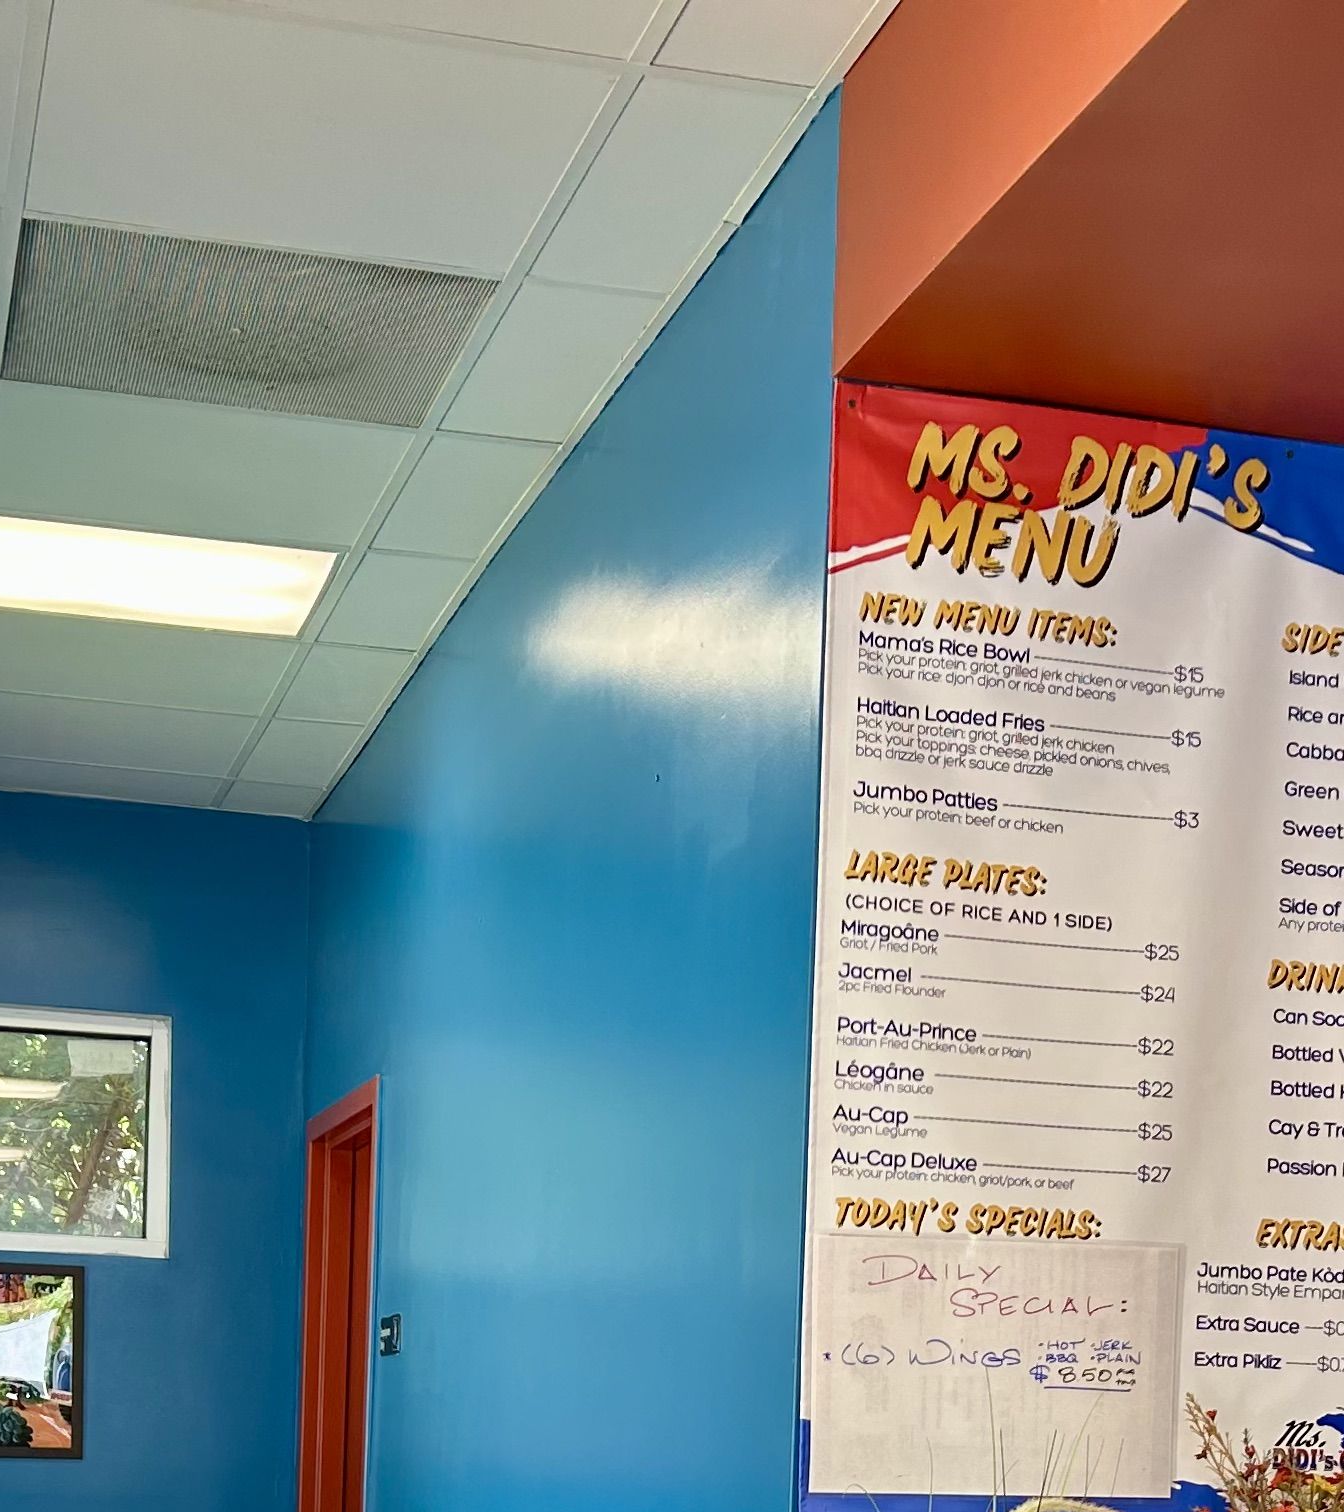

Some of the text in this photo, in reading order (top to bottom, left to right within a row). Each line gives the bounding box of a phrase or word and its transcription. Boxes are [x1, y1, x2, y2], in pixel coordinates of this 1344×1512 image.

[907, 421, 1272, 532] MS. DIDI'S
[905, 496, 1120, 588] MENU
[859, 591, 1118, 648] NEW MENU ITEMS:
[859, 630, 1204, 684] Mama's Rice Bowl $15
[1289, 670, 1339, 688] Island
[857, 697, 1201, 748] Haitian Loaded Fries $15
[1288, 706, 1323, 724] Rice
[1285, 781, 1339, 800] Green
[854, 781, 1199, 829] Jumbo Patties $3
[854, 802, 1064, 834] Pick your protein: beef or chicken
[1283, 820, 1344, 840] Sweet
[844, 849, 1048, 896] LARGE PLATES:
[846, 893, 1112, 932] (CHOICE OF RICE AND 1 SIDE)
[1279, 898, 1317, 915] Side
[1323, 901, 1341, 917] of
[1279, 917, 1304, 933] Any
[841, 920, 1179, 961] Miragoâne $25
[839, 963, 1175, 1003] Jacmel $24
[1273, 1008, 1308, 1025] Can
[837, 1016, 1174, 1056] Port-Au-Prince $22
[1272, 1045, 1333, 1063] Bottled
[836, 1059, 1173, 1098] Léogâne $22
[1271, 1080, 1334, 1099] Bottled
[833, 1104, 1173, 1141] Au-Cap $25
[1268, 1119, 1303, 1140] Cay
[1308, 1122, 1320, 1137] &
[831, 1148, 1172, 1184] Au-Cap Deluxe $27
[1268, 1158, 1337, 1177] Passion
[835, 1197, 1102, 1239] TODAY'S SPECIALS:
[862, 1254, 1002, 1286] DAILY
[1197, 1263, 1262, 1280] Jumbo
[1267, 1265, 1307, 1282] Pate
[1197, 1280, 1249, 1296] Haitian
[1251, 1283, 1290, 1298] Style
[1196, 1315, 1239, 1332] Extra
[1243, 1316, 1300, 1334] Sauce
[1046, 1352, 1141, 1364] BBQ PLAIN
[1047, 1338, 1133, 1351] HOT JERK
[1194, 1351, 1238, 1368] Extra
[1242, 1353, 1282, 1369] Pikliz
[1275, 1420, 1326, 1448] Ms.
